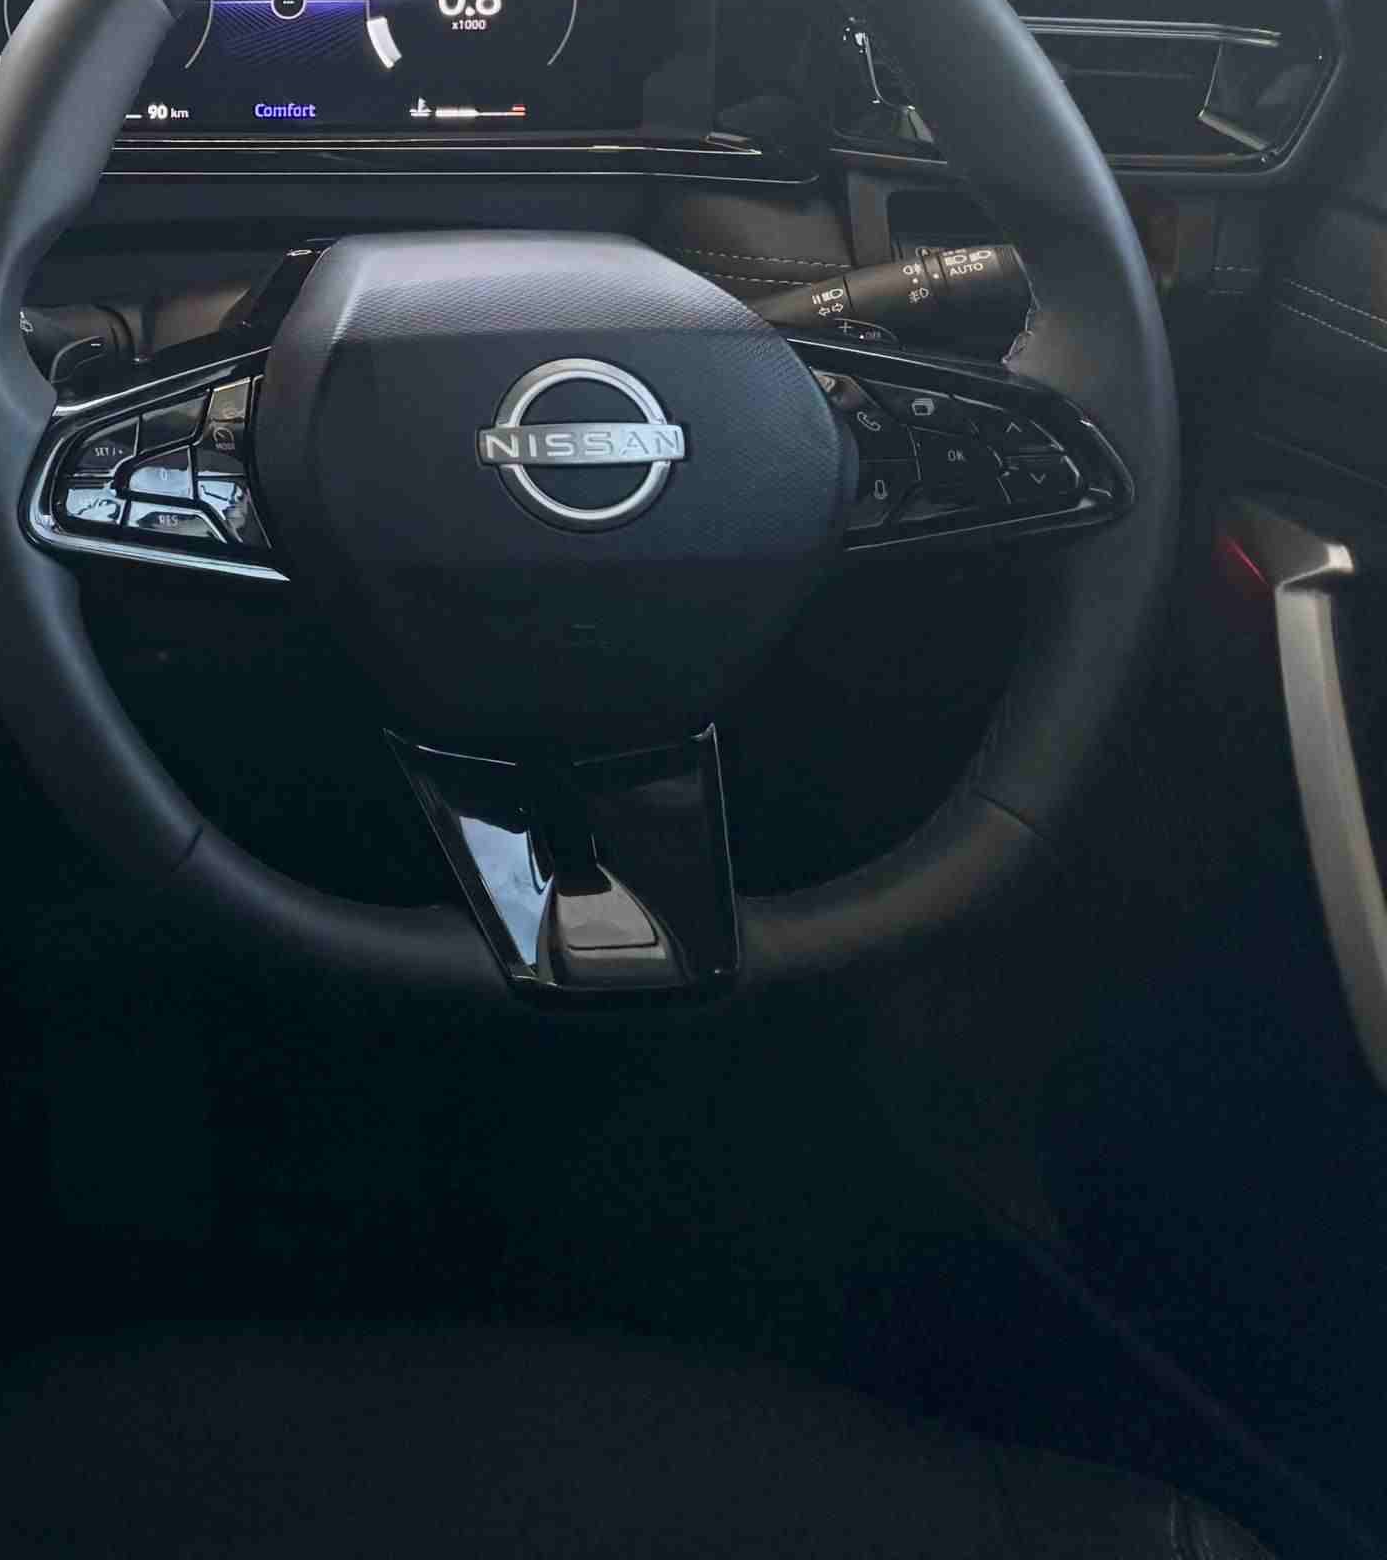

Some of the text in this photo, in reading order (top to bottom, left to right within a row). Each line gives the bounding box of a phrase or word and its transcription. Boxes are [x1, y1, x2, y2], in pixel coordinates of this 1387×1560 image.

[451, 19, 487, 30] x1000
[147, 104, 190, 120] 90 km
[254, 102, 316, 118] Comfort
[949, 262, 984, 277] AUTO
[485, 430, 681, 460] NISSAN
[947, 449, 965, 462] OK
